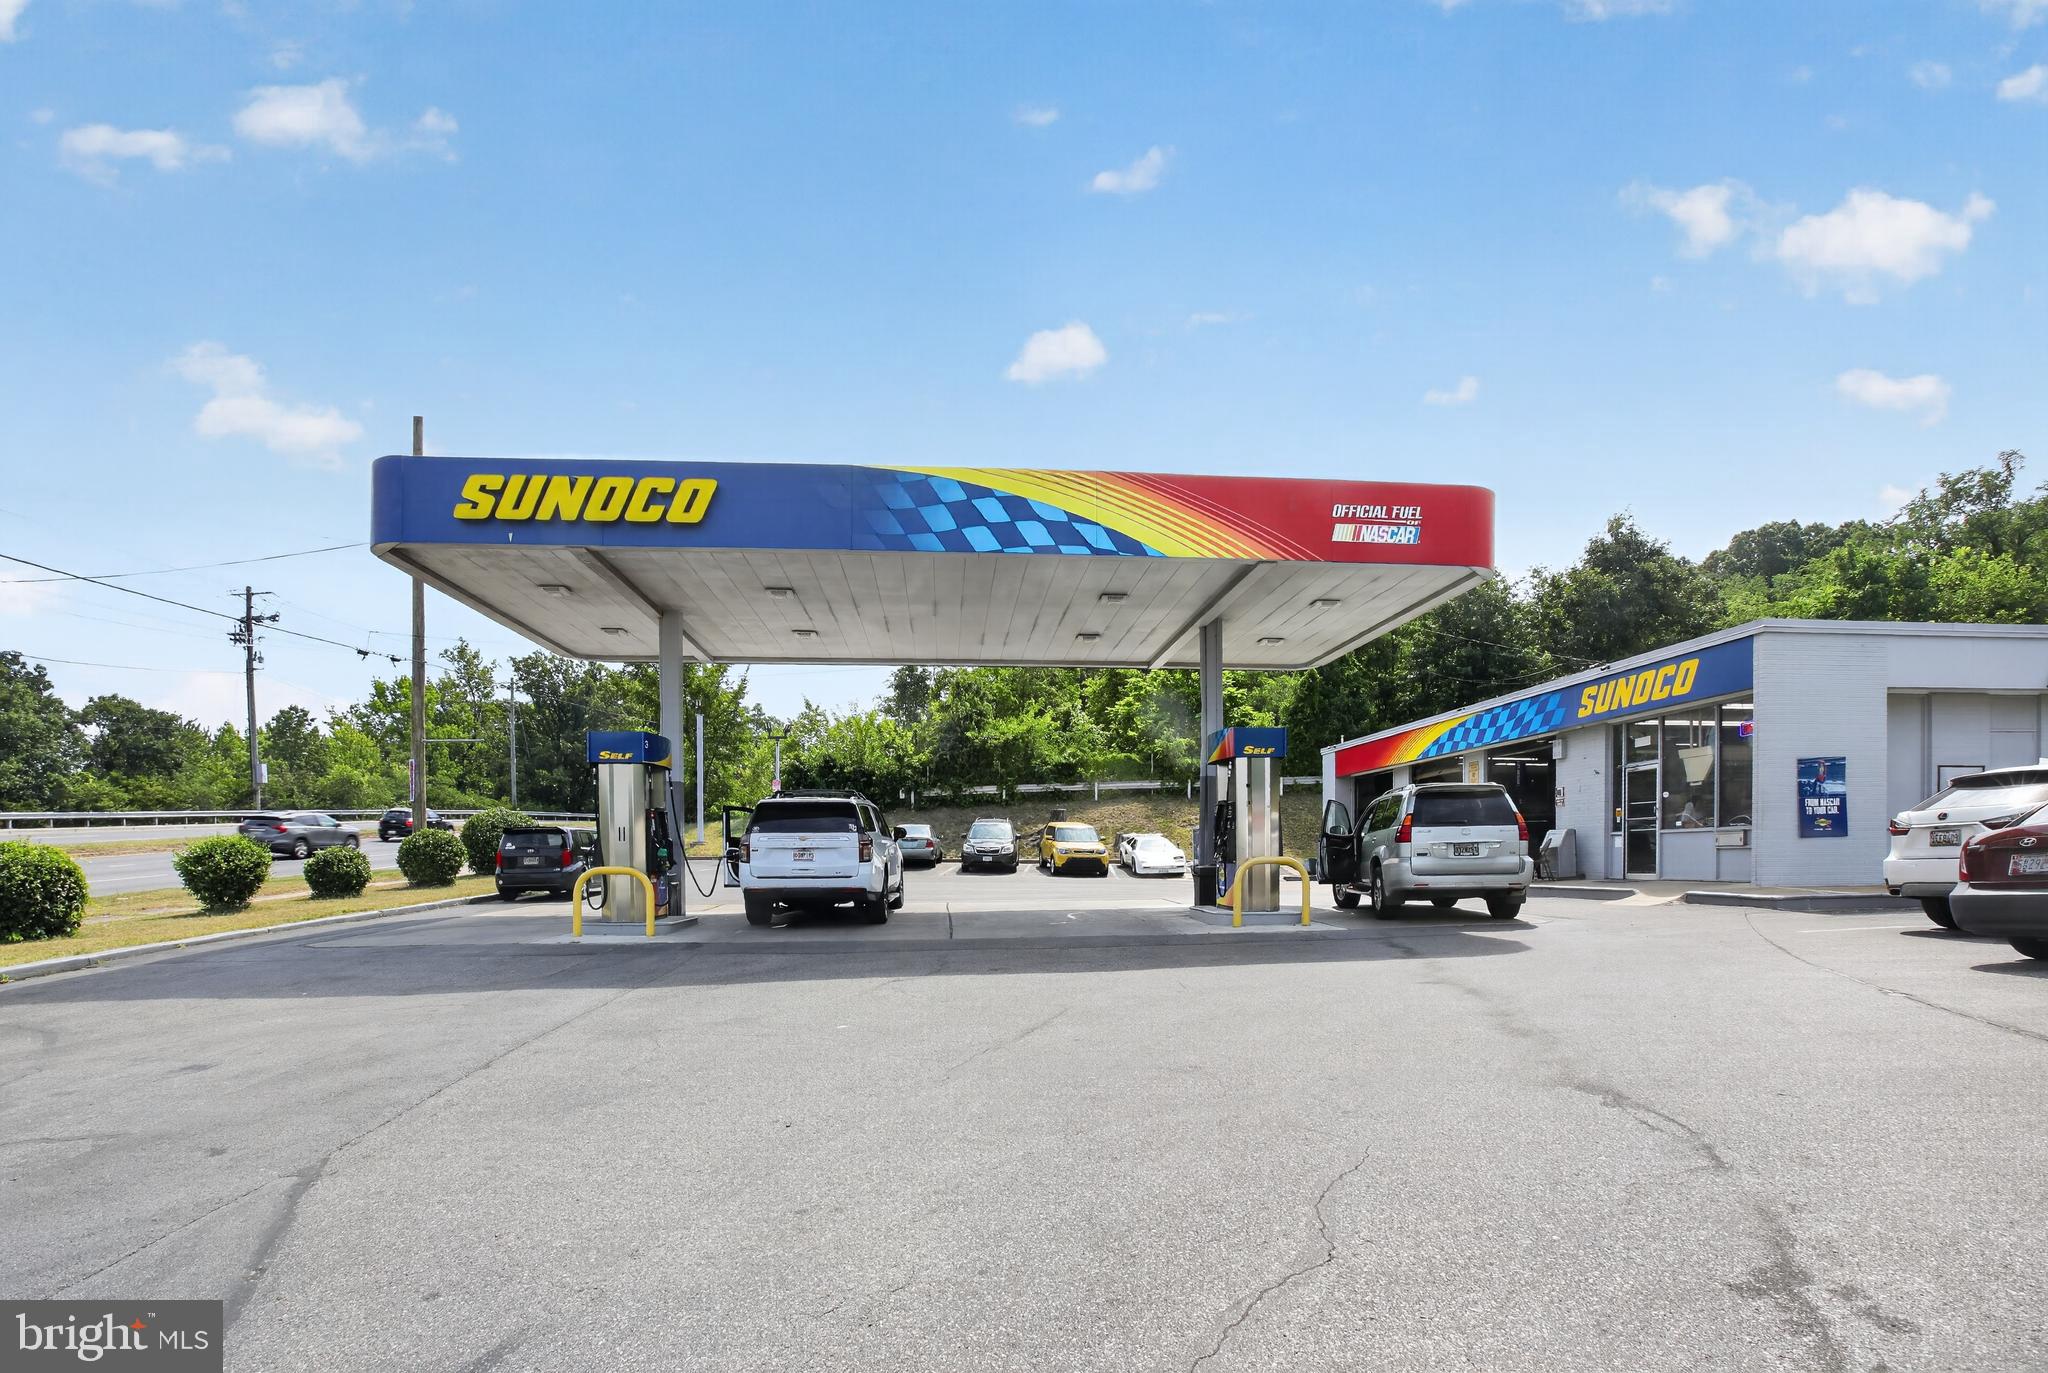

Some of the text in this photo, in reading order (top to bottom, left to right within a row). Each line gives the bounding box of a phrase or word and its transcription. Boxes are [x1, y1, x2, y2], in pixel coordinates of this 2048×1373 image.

[453, 474, 718, 524] SUNOCO
[1332, 504, 1423, 520] OFFICIAL FUEL
[1360, 525, 1416, 544] NASCAR
[1577, 658, 1700, 718] SUNOCO
[1805, 798, 1840, 807] FROM NASCAR
[1806, 807, 1813, 815] TO
[1814, 807, 1827, 815] YOUR
